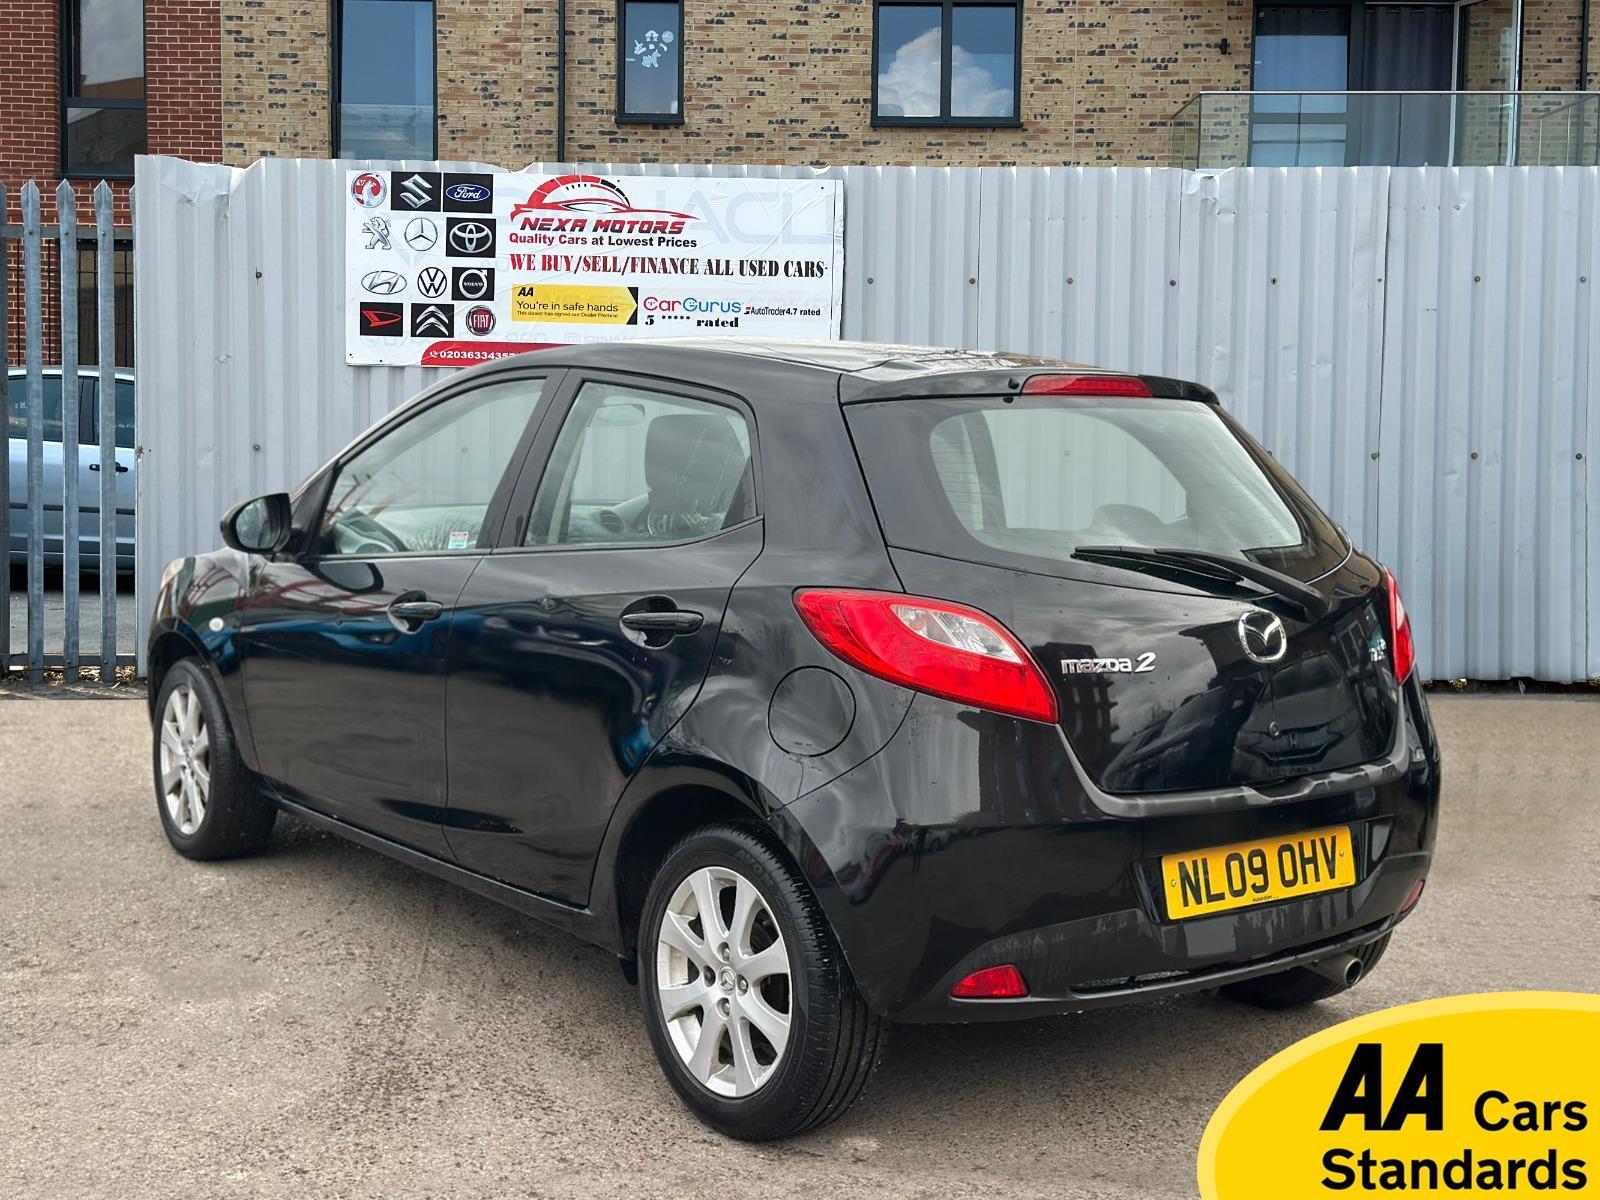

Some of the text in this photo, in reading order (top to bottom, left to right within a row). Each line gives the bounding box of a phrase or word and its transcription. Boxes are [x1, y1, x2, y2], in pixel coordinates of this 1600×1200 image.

[453, 186, 483, 199] Ford
[520, 218, 685, 234] NEXA MOTORS
[509, 232, 698, 248] Quality Cars at Lowest Prices
[510, 253, 536, 271] WE
[703, 258, 735, 276] ALL
[739, 259, 780, 278] USED
[783, 260, 826, 279] CARS
[463, 280, 484, 288] VOLVO
[517, 287, 534, 297] AA
[517, 300, 619, 313] You're in safe hands
[643, 296, 741, 313] CarGurus
[799, 307, 821, 317] rated
[474, 314, 490, 329] FIAT
[645, 315, 739, 328] 5 rated
[1178, 835, 1337, 908] NL09 OHV
